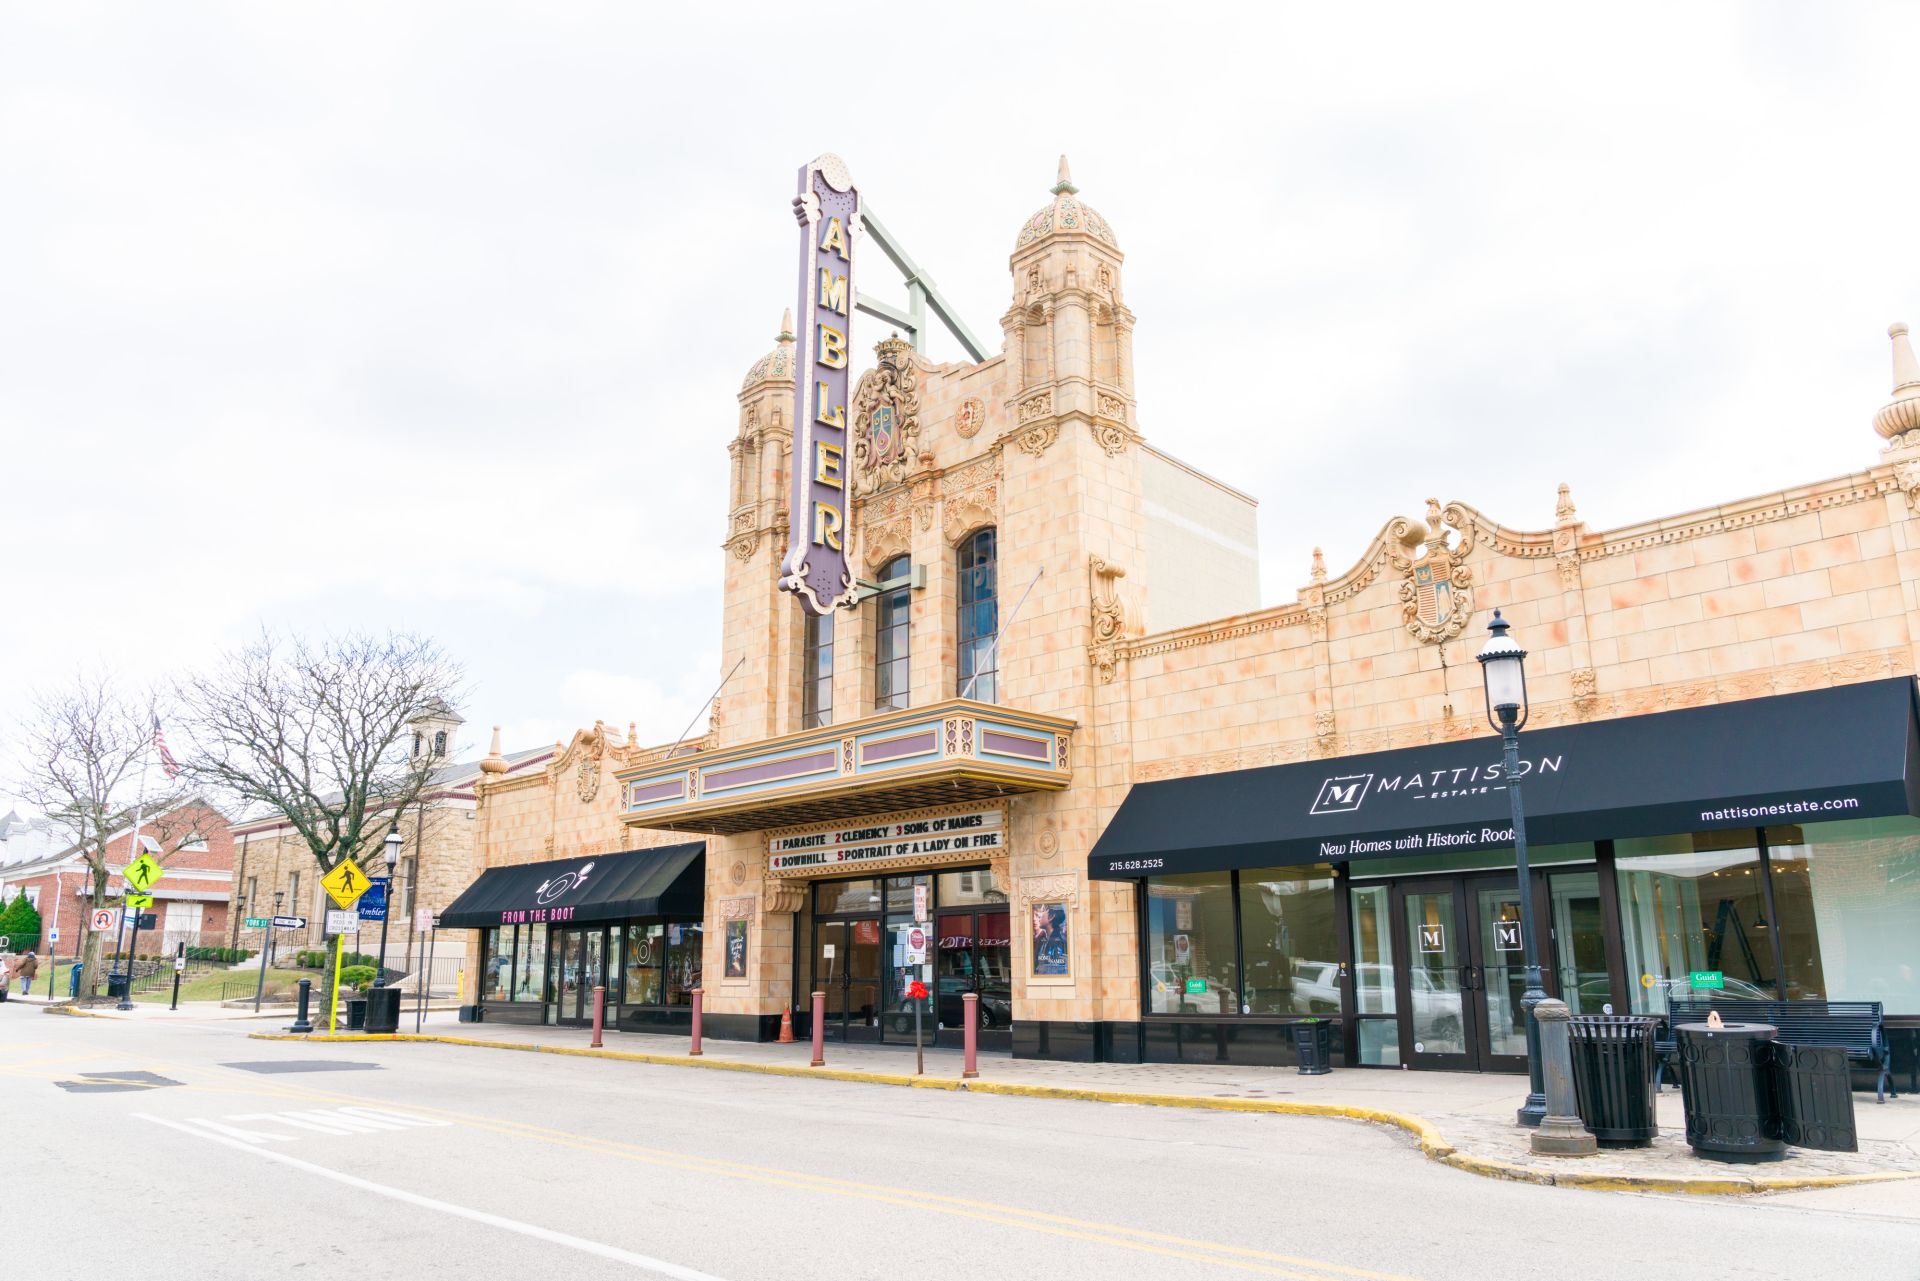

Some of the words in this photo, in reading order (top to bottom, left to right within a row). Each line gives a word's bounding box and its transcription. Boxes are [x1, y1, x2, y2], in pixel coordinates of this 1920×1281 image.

[812, 216, 850, 551] AMBLER
[1431, 786, 1488, 799] ESTATE
[1701, 797, 1859, 821] mattisonestate.com
[776, 840, 780, 850] 1
[782, 834, 826, 850] PARASITE
[835, 833, 841, 843] 2
[842, 826, 890, 842] CLEMENCY
[896, 825, 902, 836] 3
[903, 821, 929, 835] SONG
[932, 819, 947, 831] OF
[948, 815, 983, 829] NAMES
[774, 857, 779, 867] 4
[782, 852, 827, 867] DOWNHILL
[837, 850, 844, 861] 5
[844, 844, 892, 861] PORTRAIT
[896, 843, 910, 855] OF
[912, 842, 919, 853] A
[923, 838, 950, 852] LADY
[954, 836, 968, 849] ON
[973, 833, 998, 847] FIRE
[1319, 842, 1346, 856] New
[1349, 839, 1392, 854] Homes
[1398, 835, 1423, 850] with
[1426, 830, 1476, 847] Historic
[1109, 858, 1164, 871] 215.628.2525
[360, 907, 386, 916] Ambler
[502, 910, 525, 923] FROM
[530, 908, 547, 922] THE
[551, 907, 575, 920] BOOT
[1423, 931, 1440, 946] M
[1499, 928, 1517, 944] M
[1695, 973, 1718, 981] Guidi
